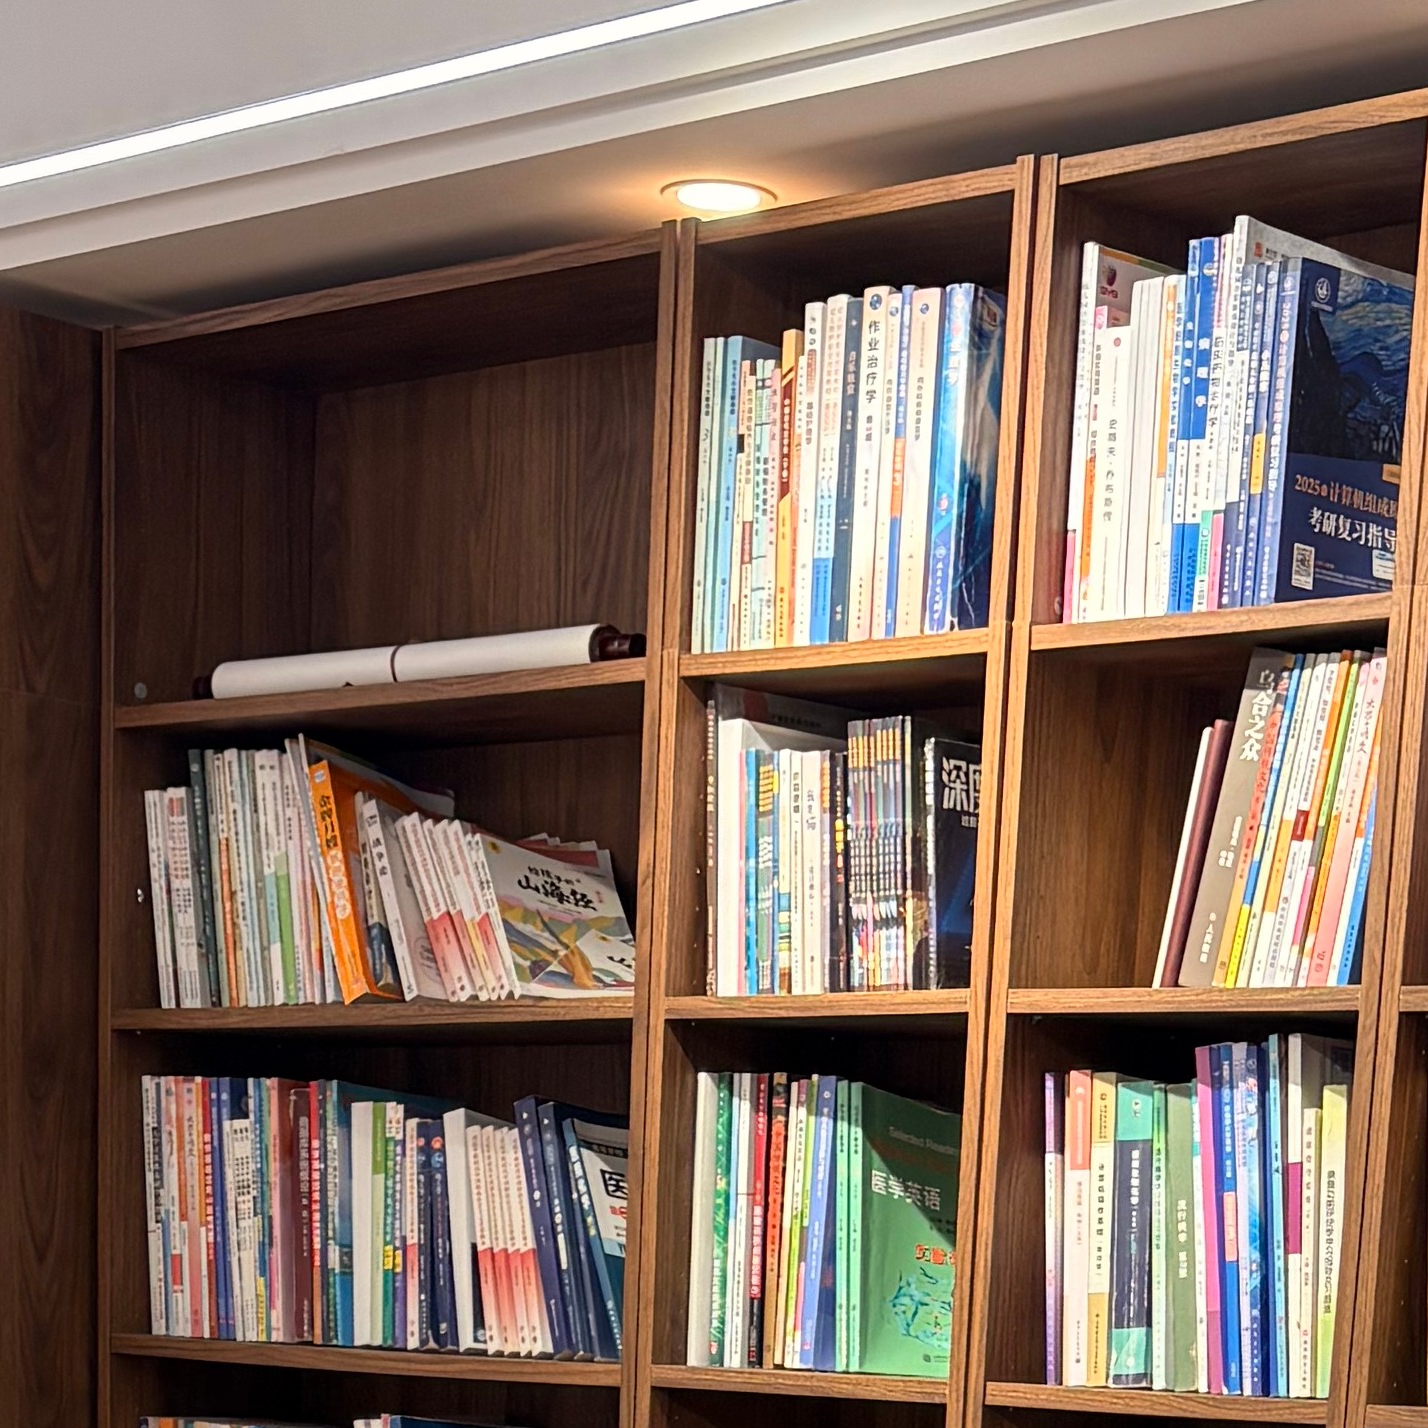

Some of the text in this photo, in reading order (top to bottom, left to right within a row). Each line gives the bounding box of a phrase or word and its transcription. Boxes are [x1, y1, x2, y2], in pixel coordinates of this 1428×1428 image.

[1295, 474, 1321, 497] 2025
[1309, 507, 1398, 551] 考研复习指导
[517, 875, 598, 912] 山海经
